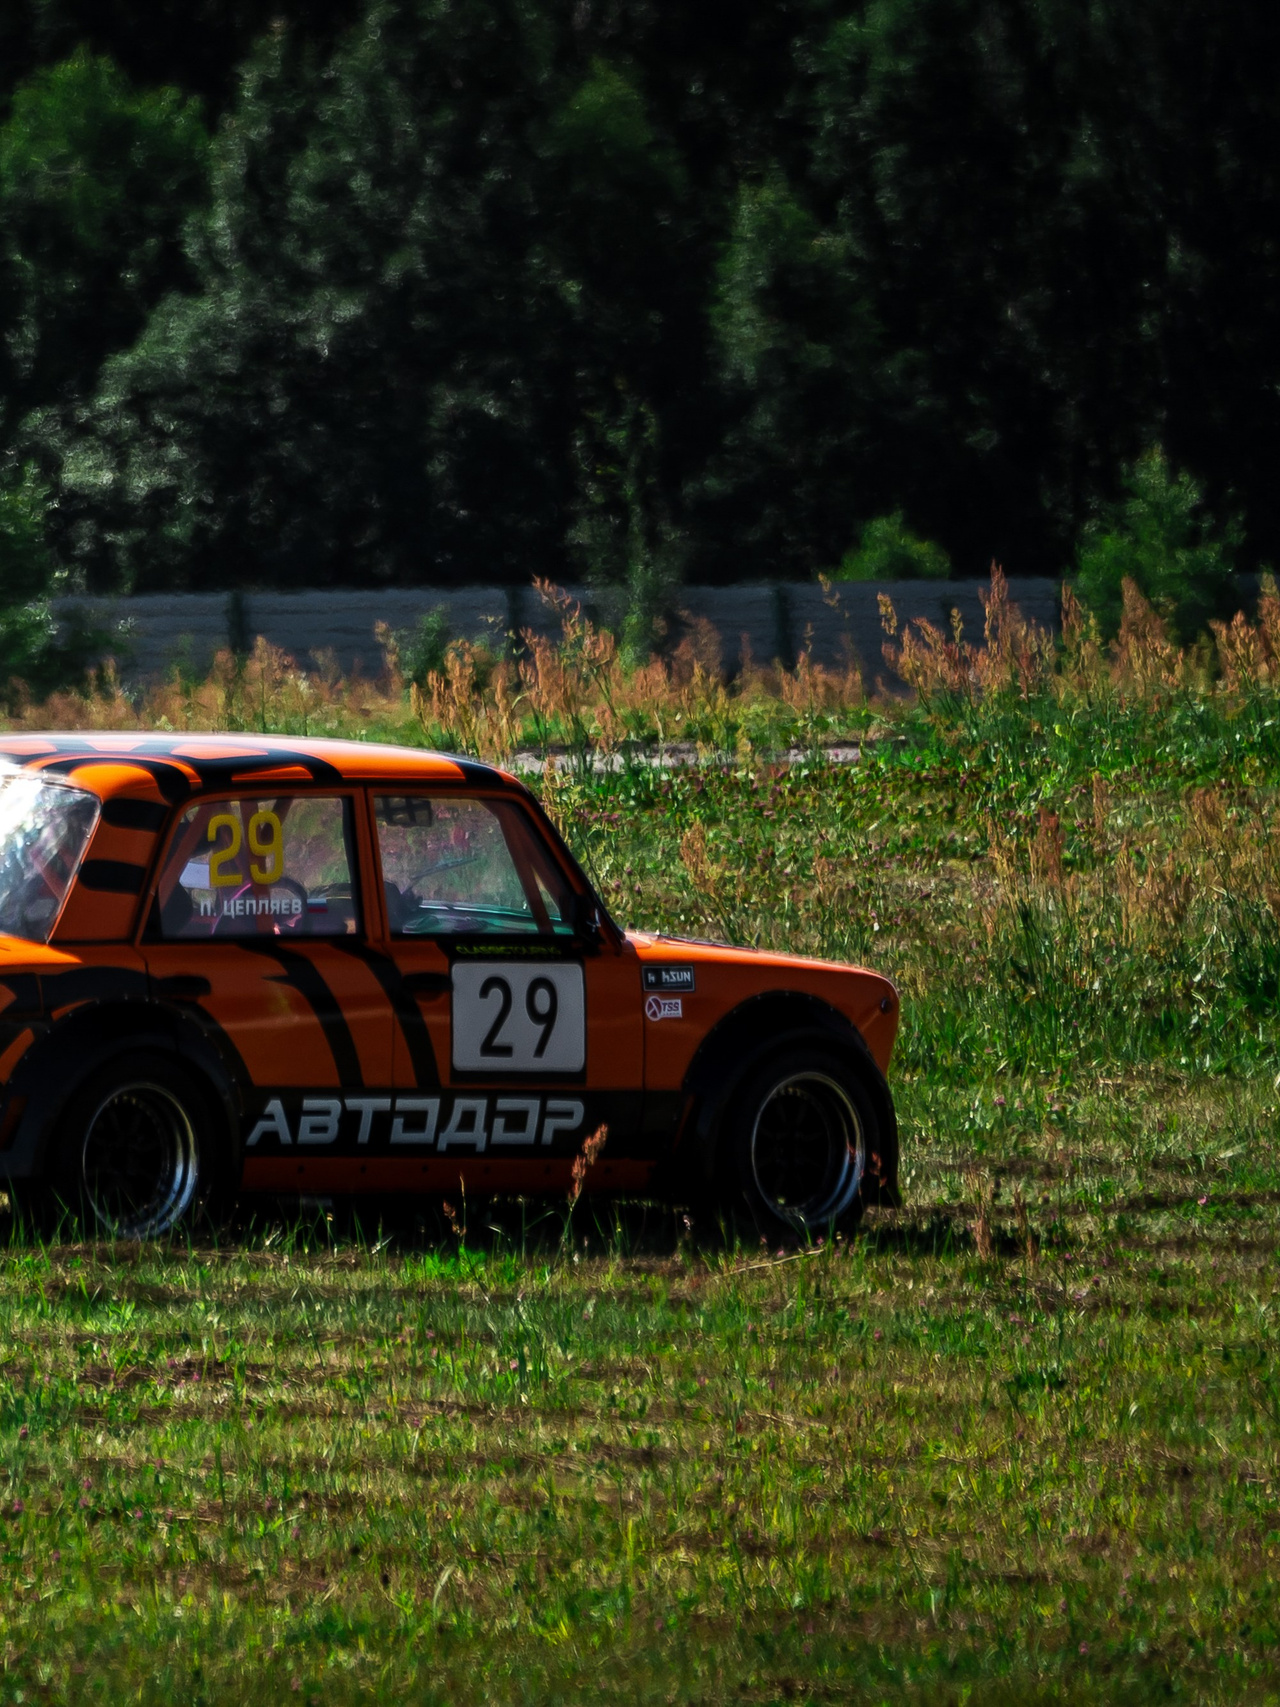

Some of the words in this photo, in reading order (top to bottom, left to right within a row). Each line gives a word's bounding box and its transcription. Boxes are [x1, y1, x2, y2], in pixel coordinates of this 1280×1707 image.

[207, 810, 284, 888] 29
[223, 899, 302, 919] ЦЕПЛЯЕВ
[478, 976, 559, 1059] 29
[246, 1098, 585, 1152] АВТОДОР
